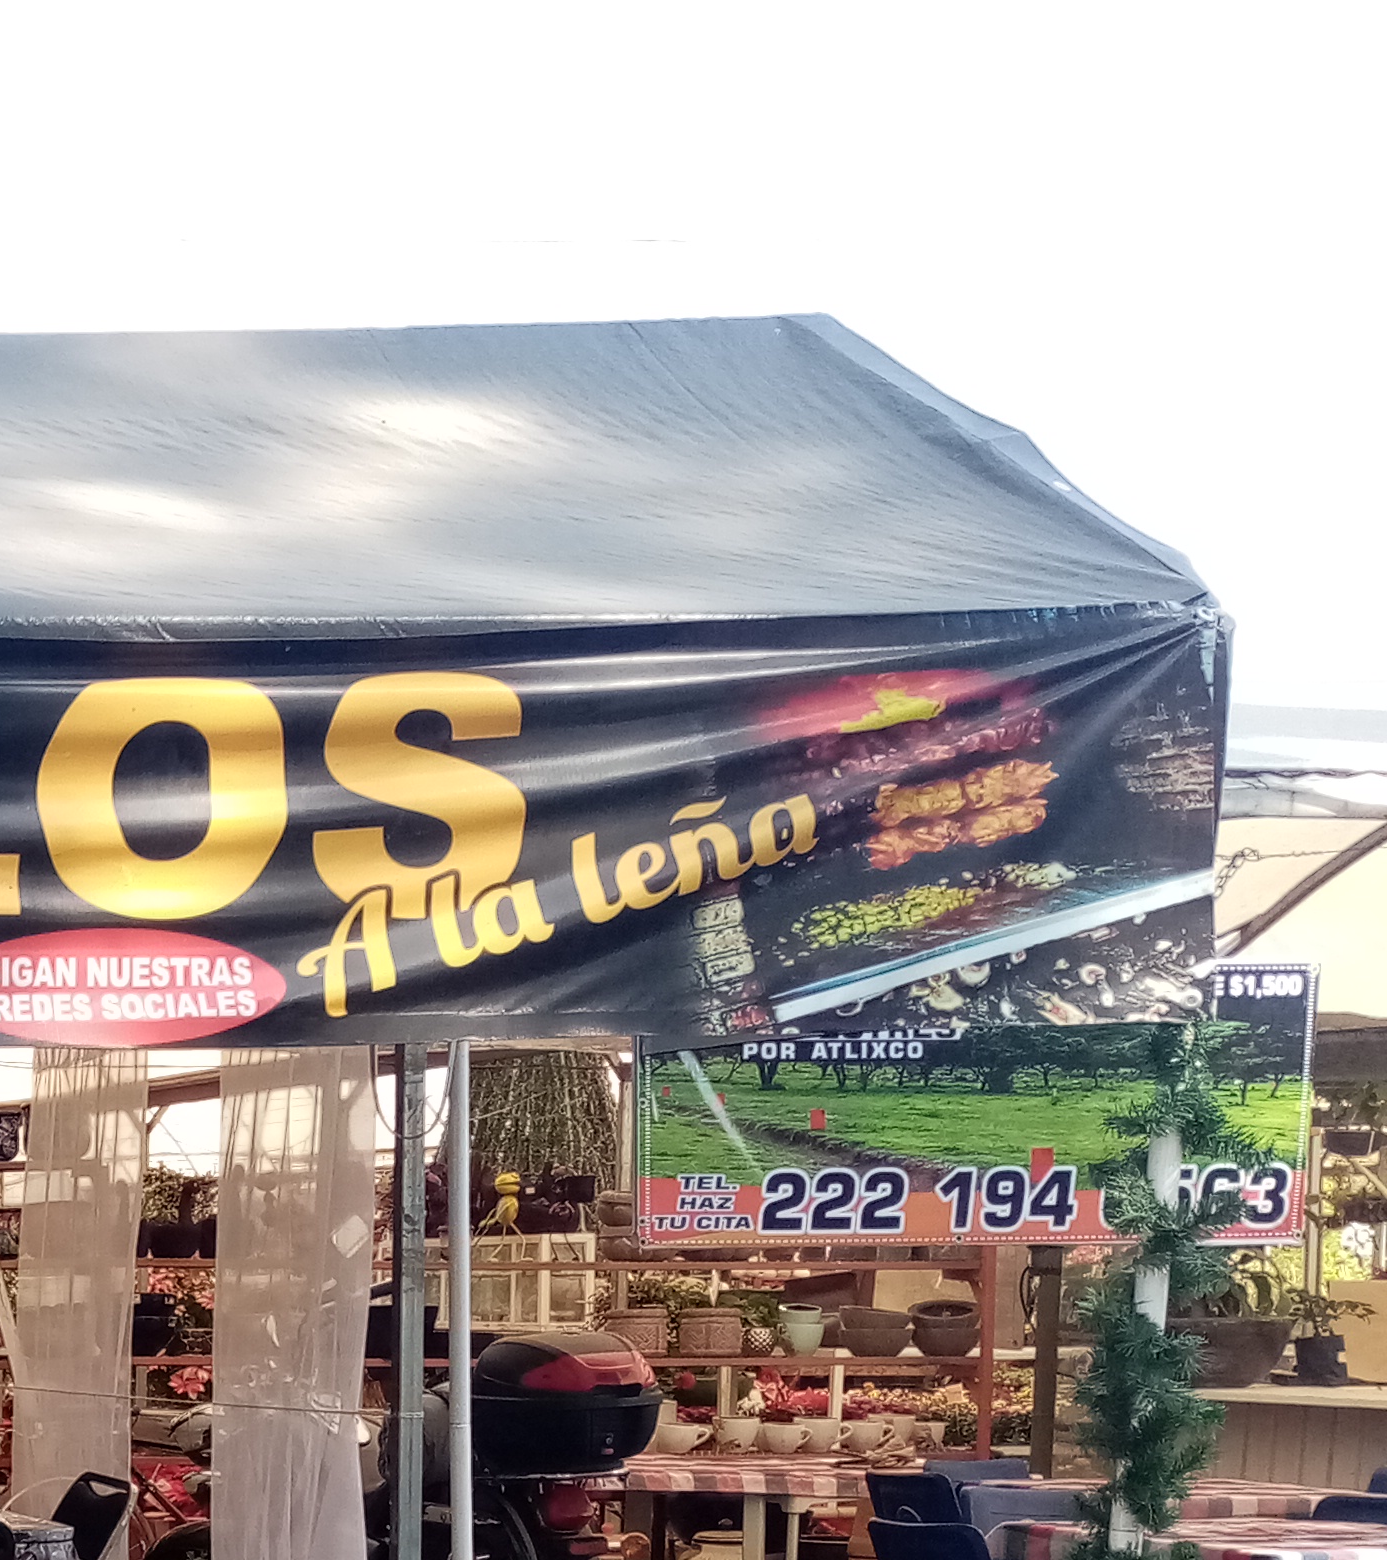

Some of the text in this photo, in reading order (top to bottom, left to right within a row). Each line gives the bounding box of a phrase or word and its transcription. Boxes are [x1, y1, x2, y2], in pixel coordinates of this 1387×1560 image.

[296, 794, 820, 1018] A la leña
[87, 957, 253, 989] NUESTRAS
[1228, 974, 1304, 999] $1,500
[101, 991, 258, 1020] SOCIALES
[742, 1041, 924, 1060] POR ATLIXCO
[679, 1174, 739, 1191] TEL.
[678, 1194, 734, 1211] HAZ
[757, 1167, 910, 1234] 222
[936, 1165, 1077, 1232] 194
[654, 1214, 754, 1231] TU CITA
